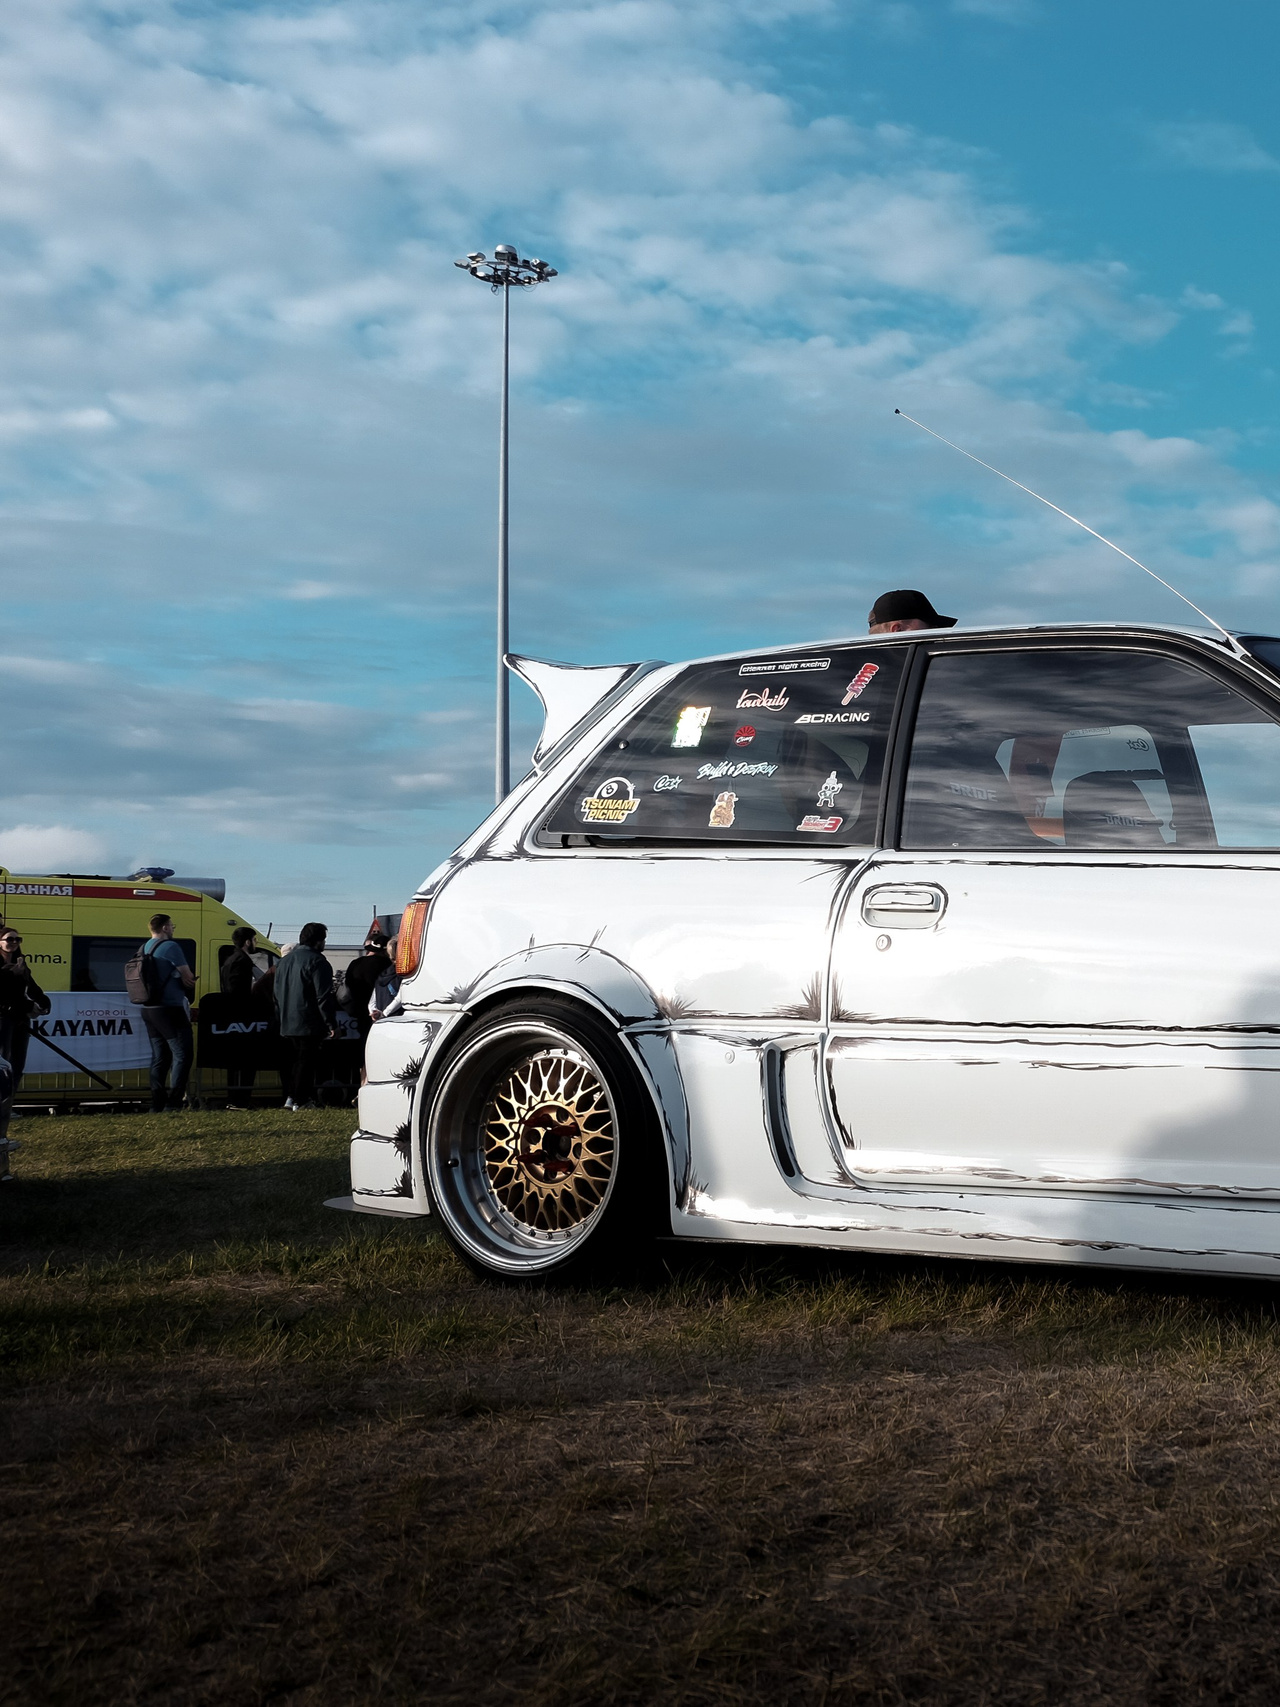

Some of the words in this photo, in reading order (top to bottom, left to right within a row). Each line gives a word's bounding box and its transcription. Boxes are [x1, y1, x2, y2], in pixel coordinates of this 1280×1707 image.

[949, 782, 998, 802] BRIDE
[584, 798, 637, 811] TSUNAMI
[587, 810, 628, 821] PICNIC
[77, 1009, 111, 1017] MOTOR
